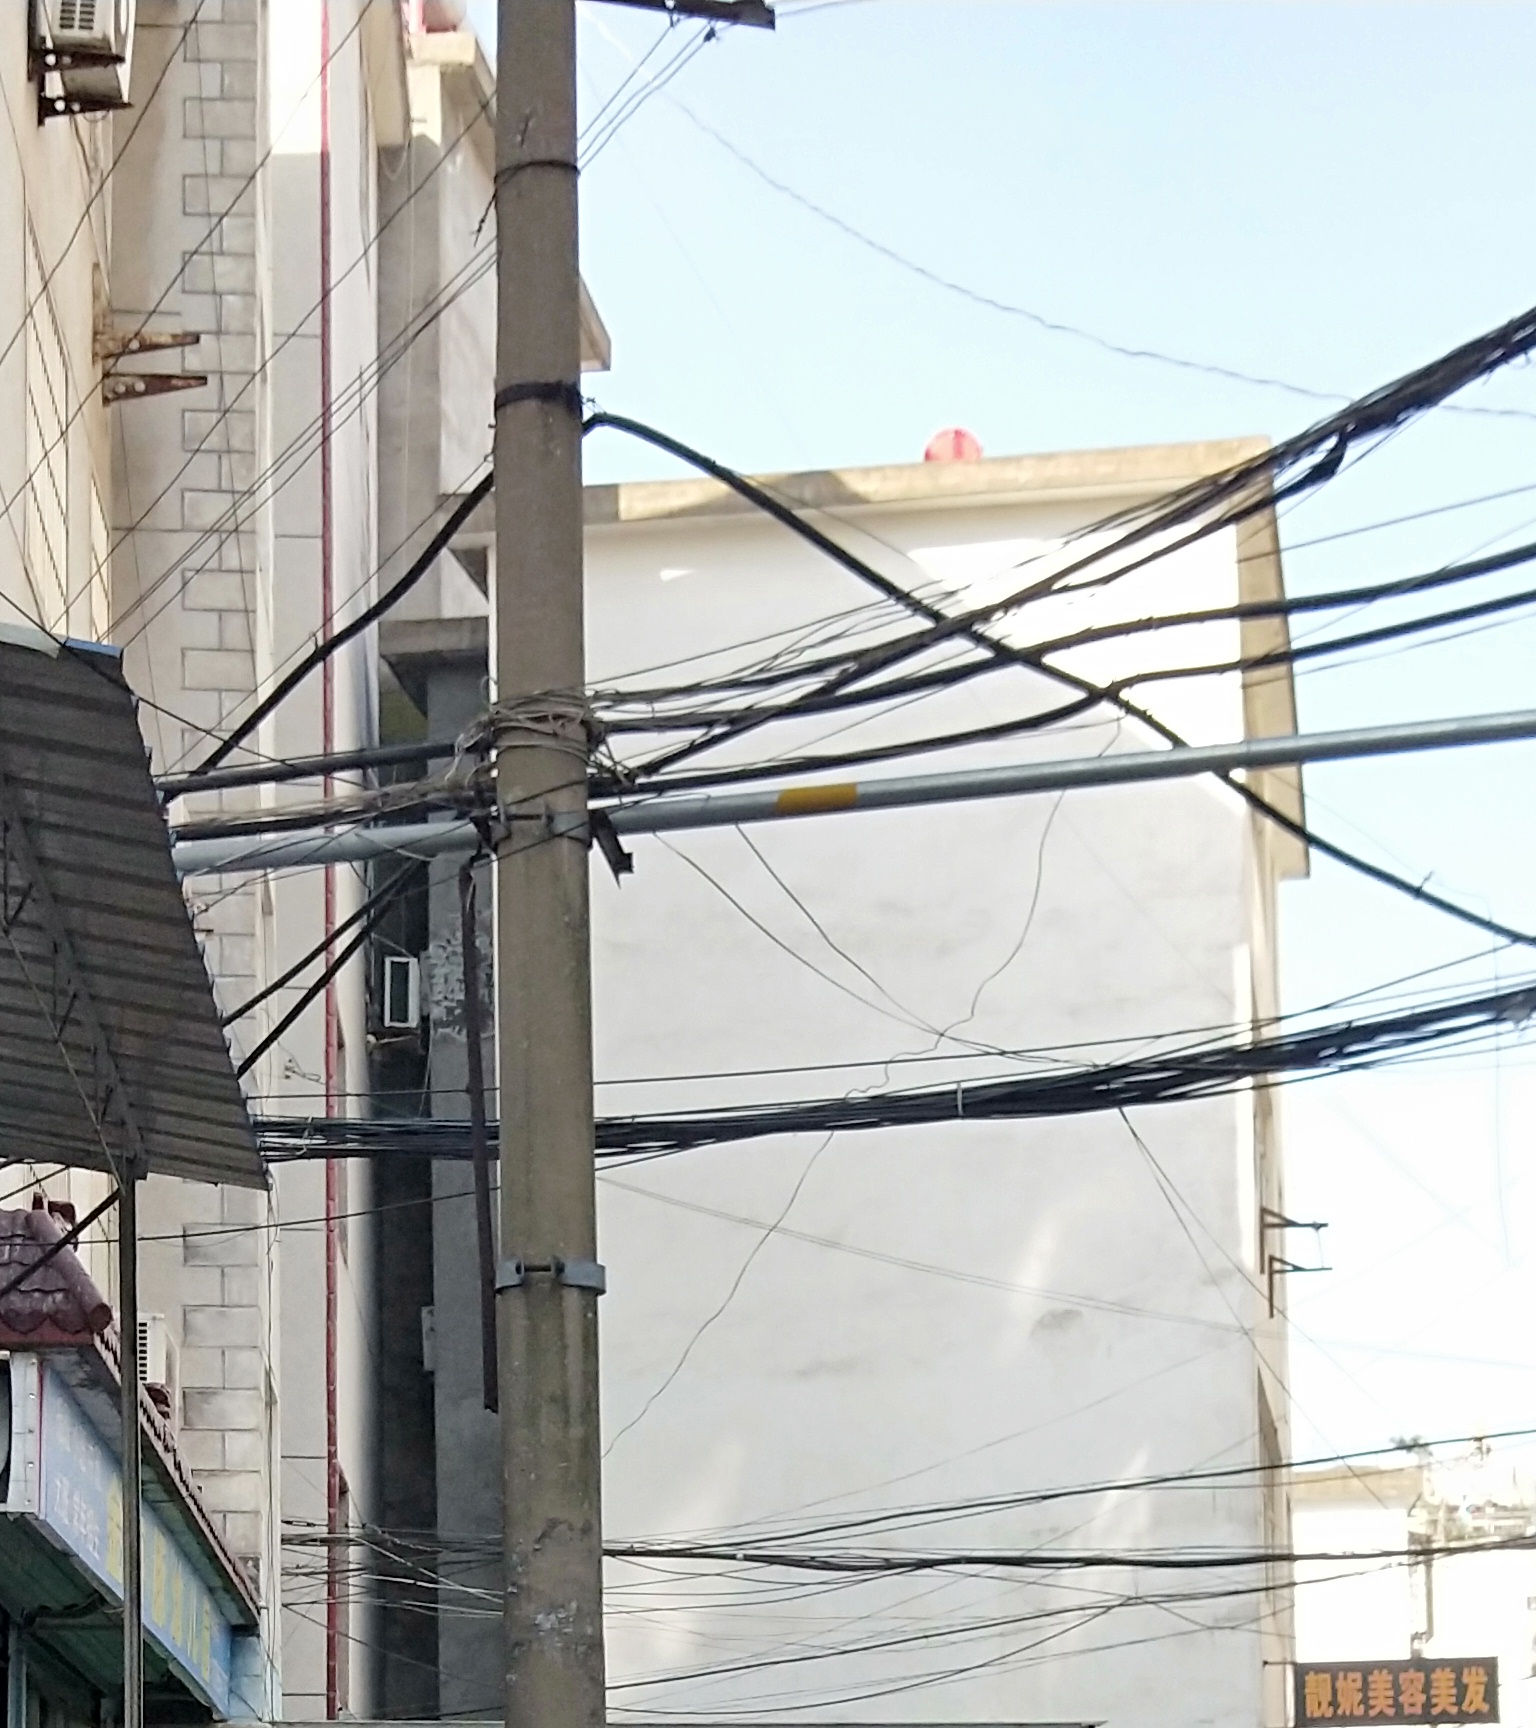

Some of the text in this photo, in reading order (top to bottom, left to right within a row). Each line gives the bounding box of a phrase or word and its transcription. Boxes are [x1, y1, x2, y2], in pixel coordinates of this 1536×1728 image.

[1304, 1666, 1490, 1718] 靓妮美容美发
